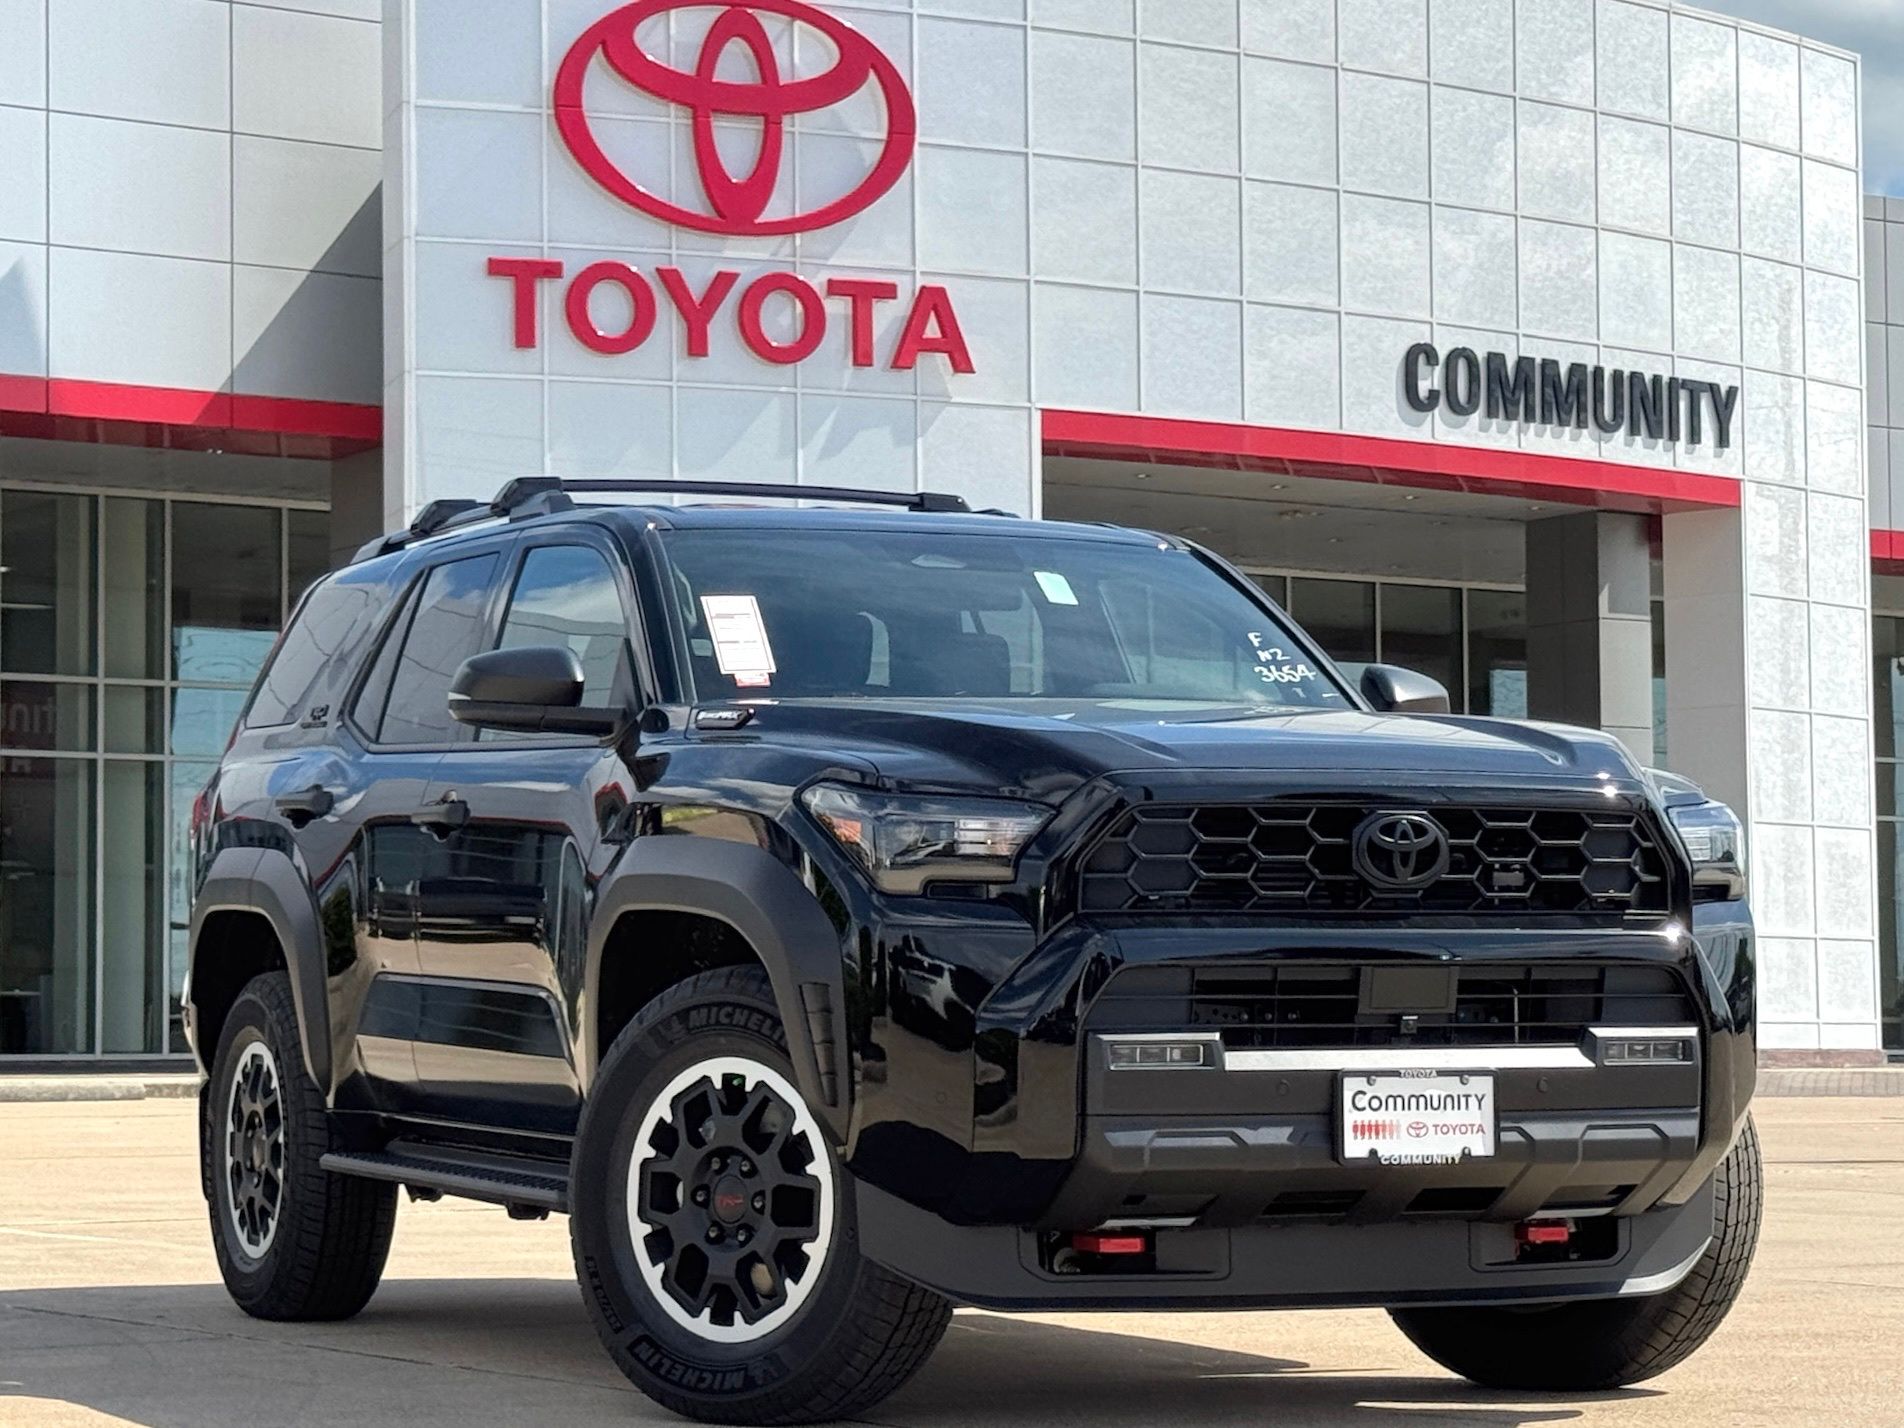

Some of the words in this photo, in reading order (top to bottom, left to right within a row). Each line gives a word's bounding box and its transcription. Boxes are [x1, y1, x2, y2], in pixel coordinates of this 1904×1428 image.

[487, 256, 976, 374] TOYOTA
[1404, 342, 1740, 449] COMMUNITY
[689, 1005, 787, 1042] MICHELI
[1399, 1068, 1438, 1079] TOYOTA
[1432, 1123, 1486, 1136] TOYOTA
[1379, 1153, 1462, 1166] COMMUNITY
[631, 1341, 746, 1391] MICHELIN
